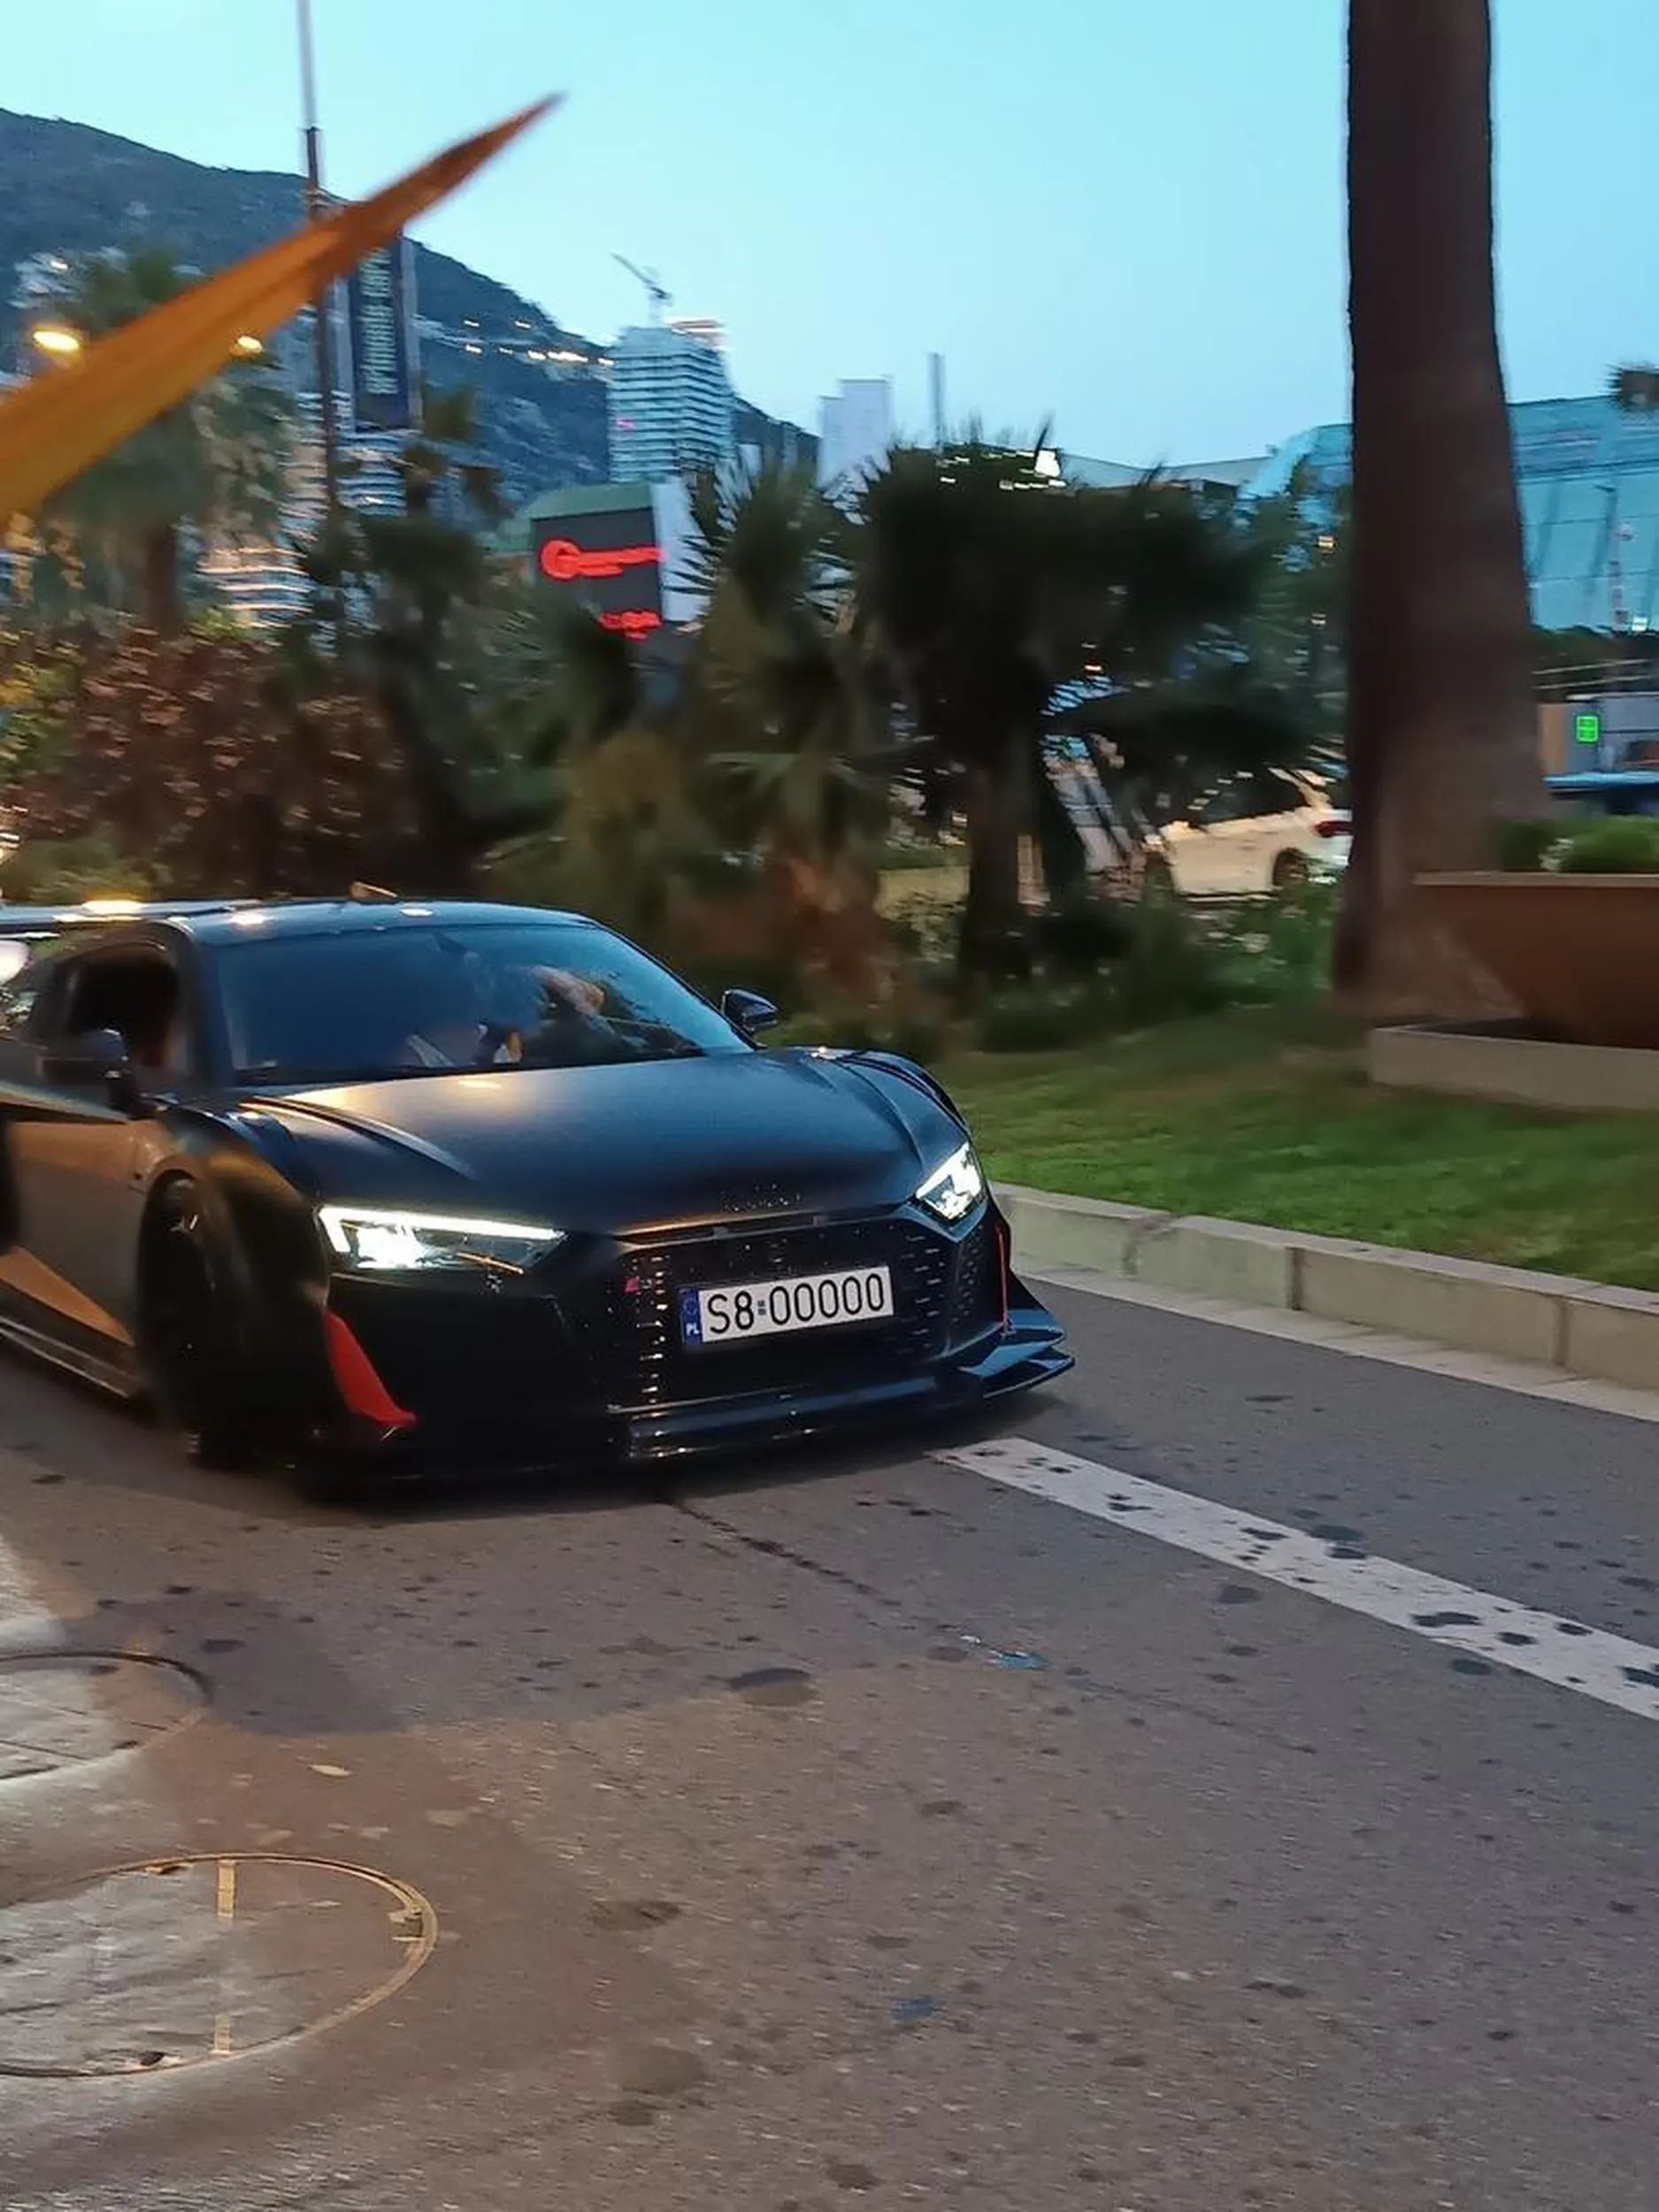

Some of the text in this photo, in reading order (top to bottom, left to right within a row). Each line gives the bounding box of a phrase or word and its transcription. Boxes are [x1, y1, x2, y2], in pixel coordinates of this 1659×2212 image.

[707, 1273, 884, 1333] S8 00000
[686, 1322, 700, 1336] PL
